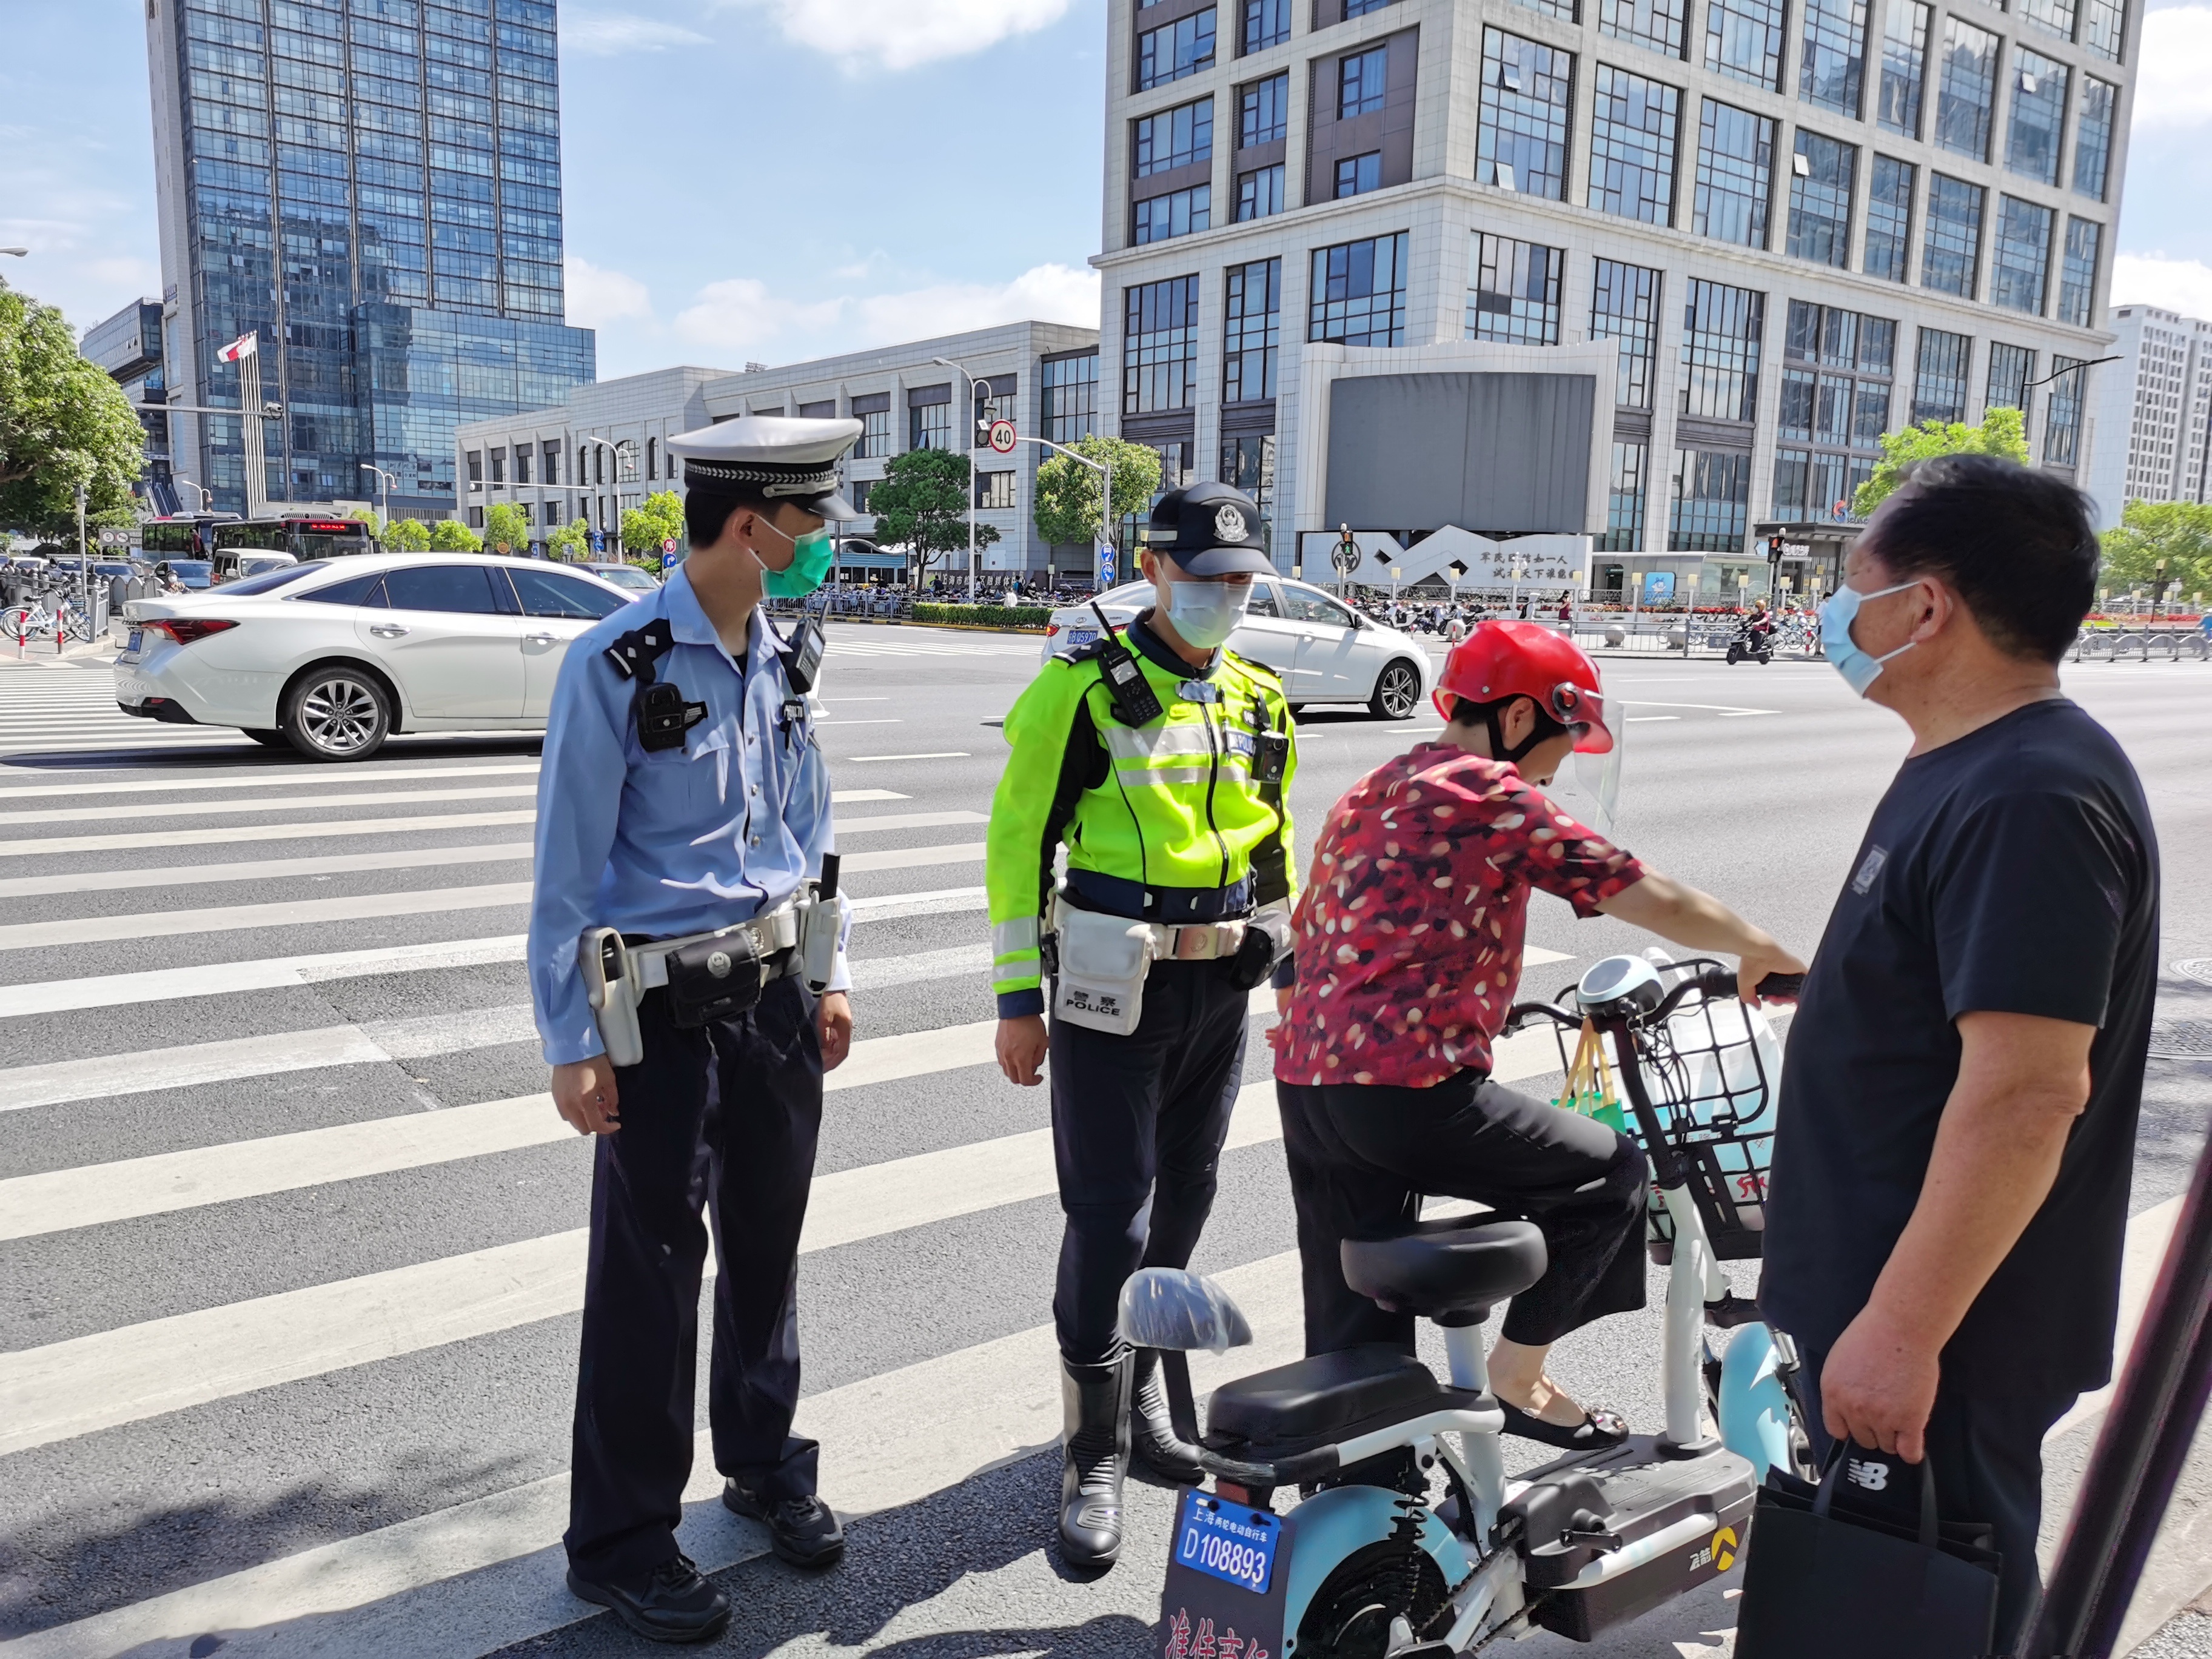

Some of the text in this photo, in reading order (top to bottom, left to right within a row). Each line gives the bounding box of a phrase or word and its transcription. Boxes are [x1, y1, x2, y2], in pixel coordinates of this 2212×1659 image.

[995, 429, 1011, 444] 40
[1066, 999, 1121, 1016] POLICE
[1192, 1507, 1268, 1543] 上海两轮电动自行车
[1183, 1527, 1266, 1584] D108893
